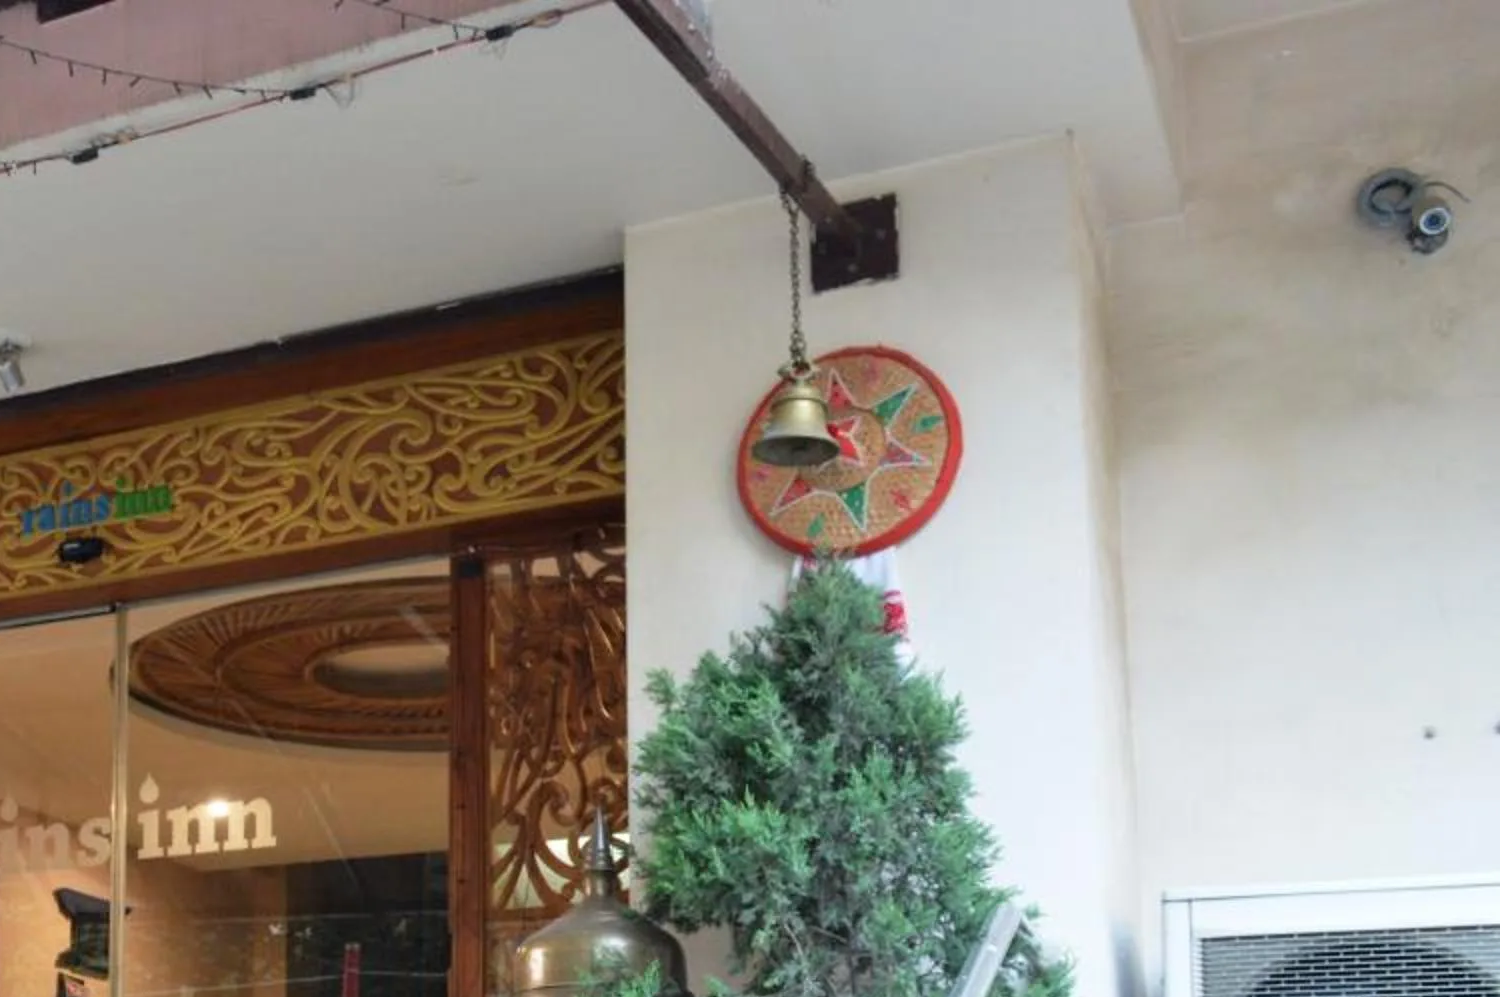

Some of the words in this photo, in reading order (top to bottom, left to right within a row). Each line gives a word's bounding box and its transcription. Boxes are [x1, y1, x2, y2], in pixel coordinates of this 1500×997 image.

[20, 480, 111, 536] rains
[113, 477, 174, 520] inn
[137, 773, 277, 860] inn
